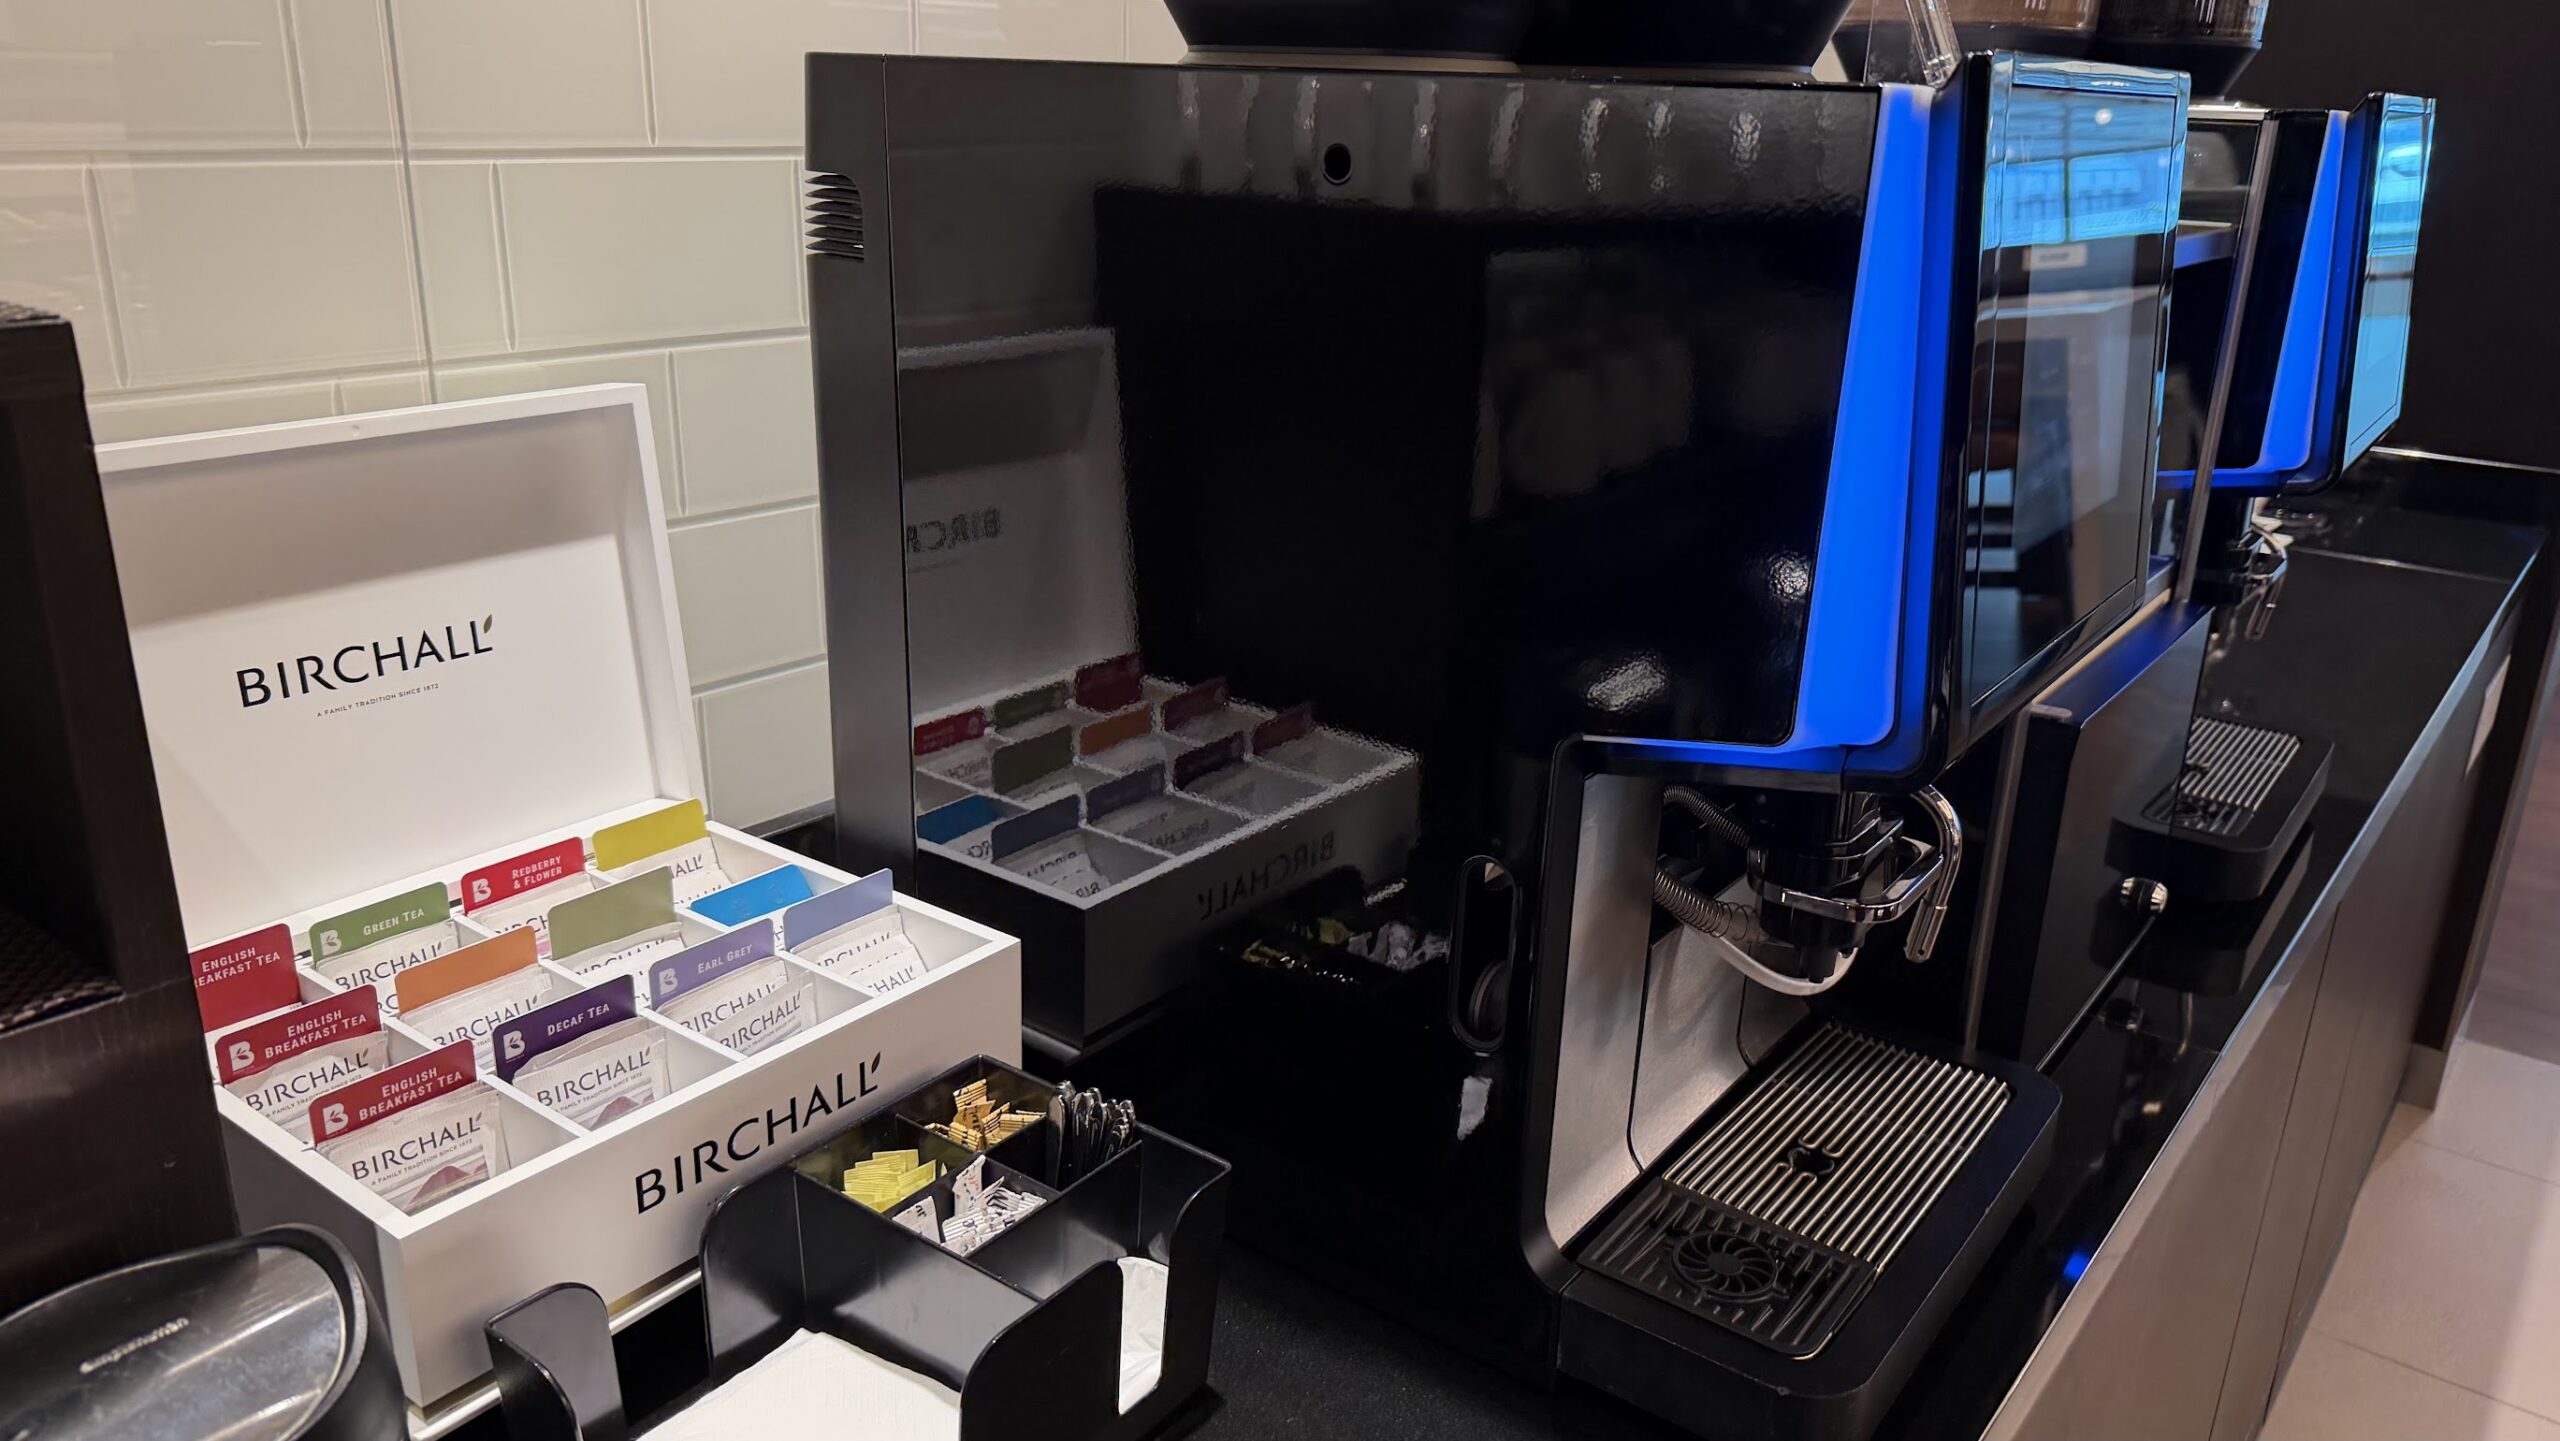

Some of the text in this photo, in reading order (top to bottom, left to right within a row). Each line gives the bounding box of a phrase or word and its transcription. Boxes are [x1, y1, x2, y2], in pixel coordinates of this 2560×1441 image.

[237, 617, 494, 708] BIRCHALL
[324, 704, 353, 716] FAMILY
[355, 693, 397, 708] TRADITION
[398, 687, 421, 698] SINCE
[511, 855, 562, 880] REDBERRY
[513, 866, 563, 890] & FLOWER
[363, 907, 425, 937] GREEN TEA
[194, 951, 281, 988] EAKFAST TEA
[201, 946, 257, 973] ENGLISH
[697, 943, 753, 974] EARL GREY
[264, 1012, 368, 1059] BREAKFAST TEA
[287, 1009, 343, 1038] ENGLISH
[547, 1002, 610, 1037] DECAF TEA
[246, 1052, 369, 1112] BIRCHALL
[382, 1066, 438, 1097] ENGLISH
[536, 1050, 651, 1107] BIRCHALL
[359, 1071, 463, 1120] BREAKFAST TEA
[351, 1116, 481, 1181] BIRCHALL
[634, 1057, 880, 1215] BIRCHALL
[378, 1170, 402, 1185] FAMILY
